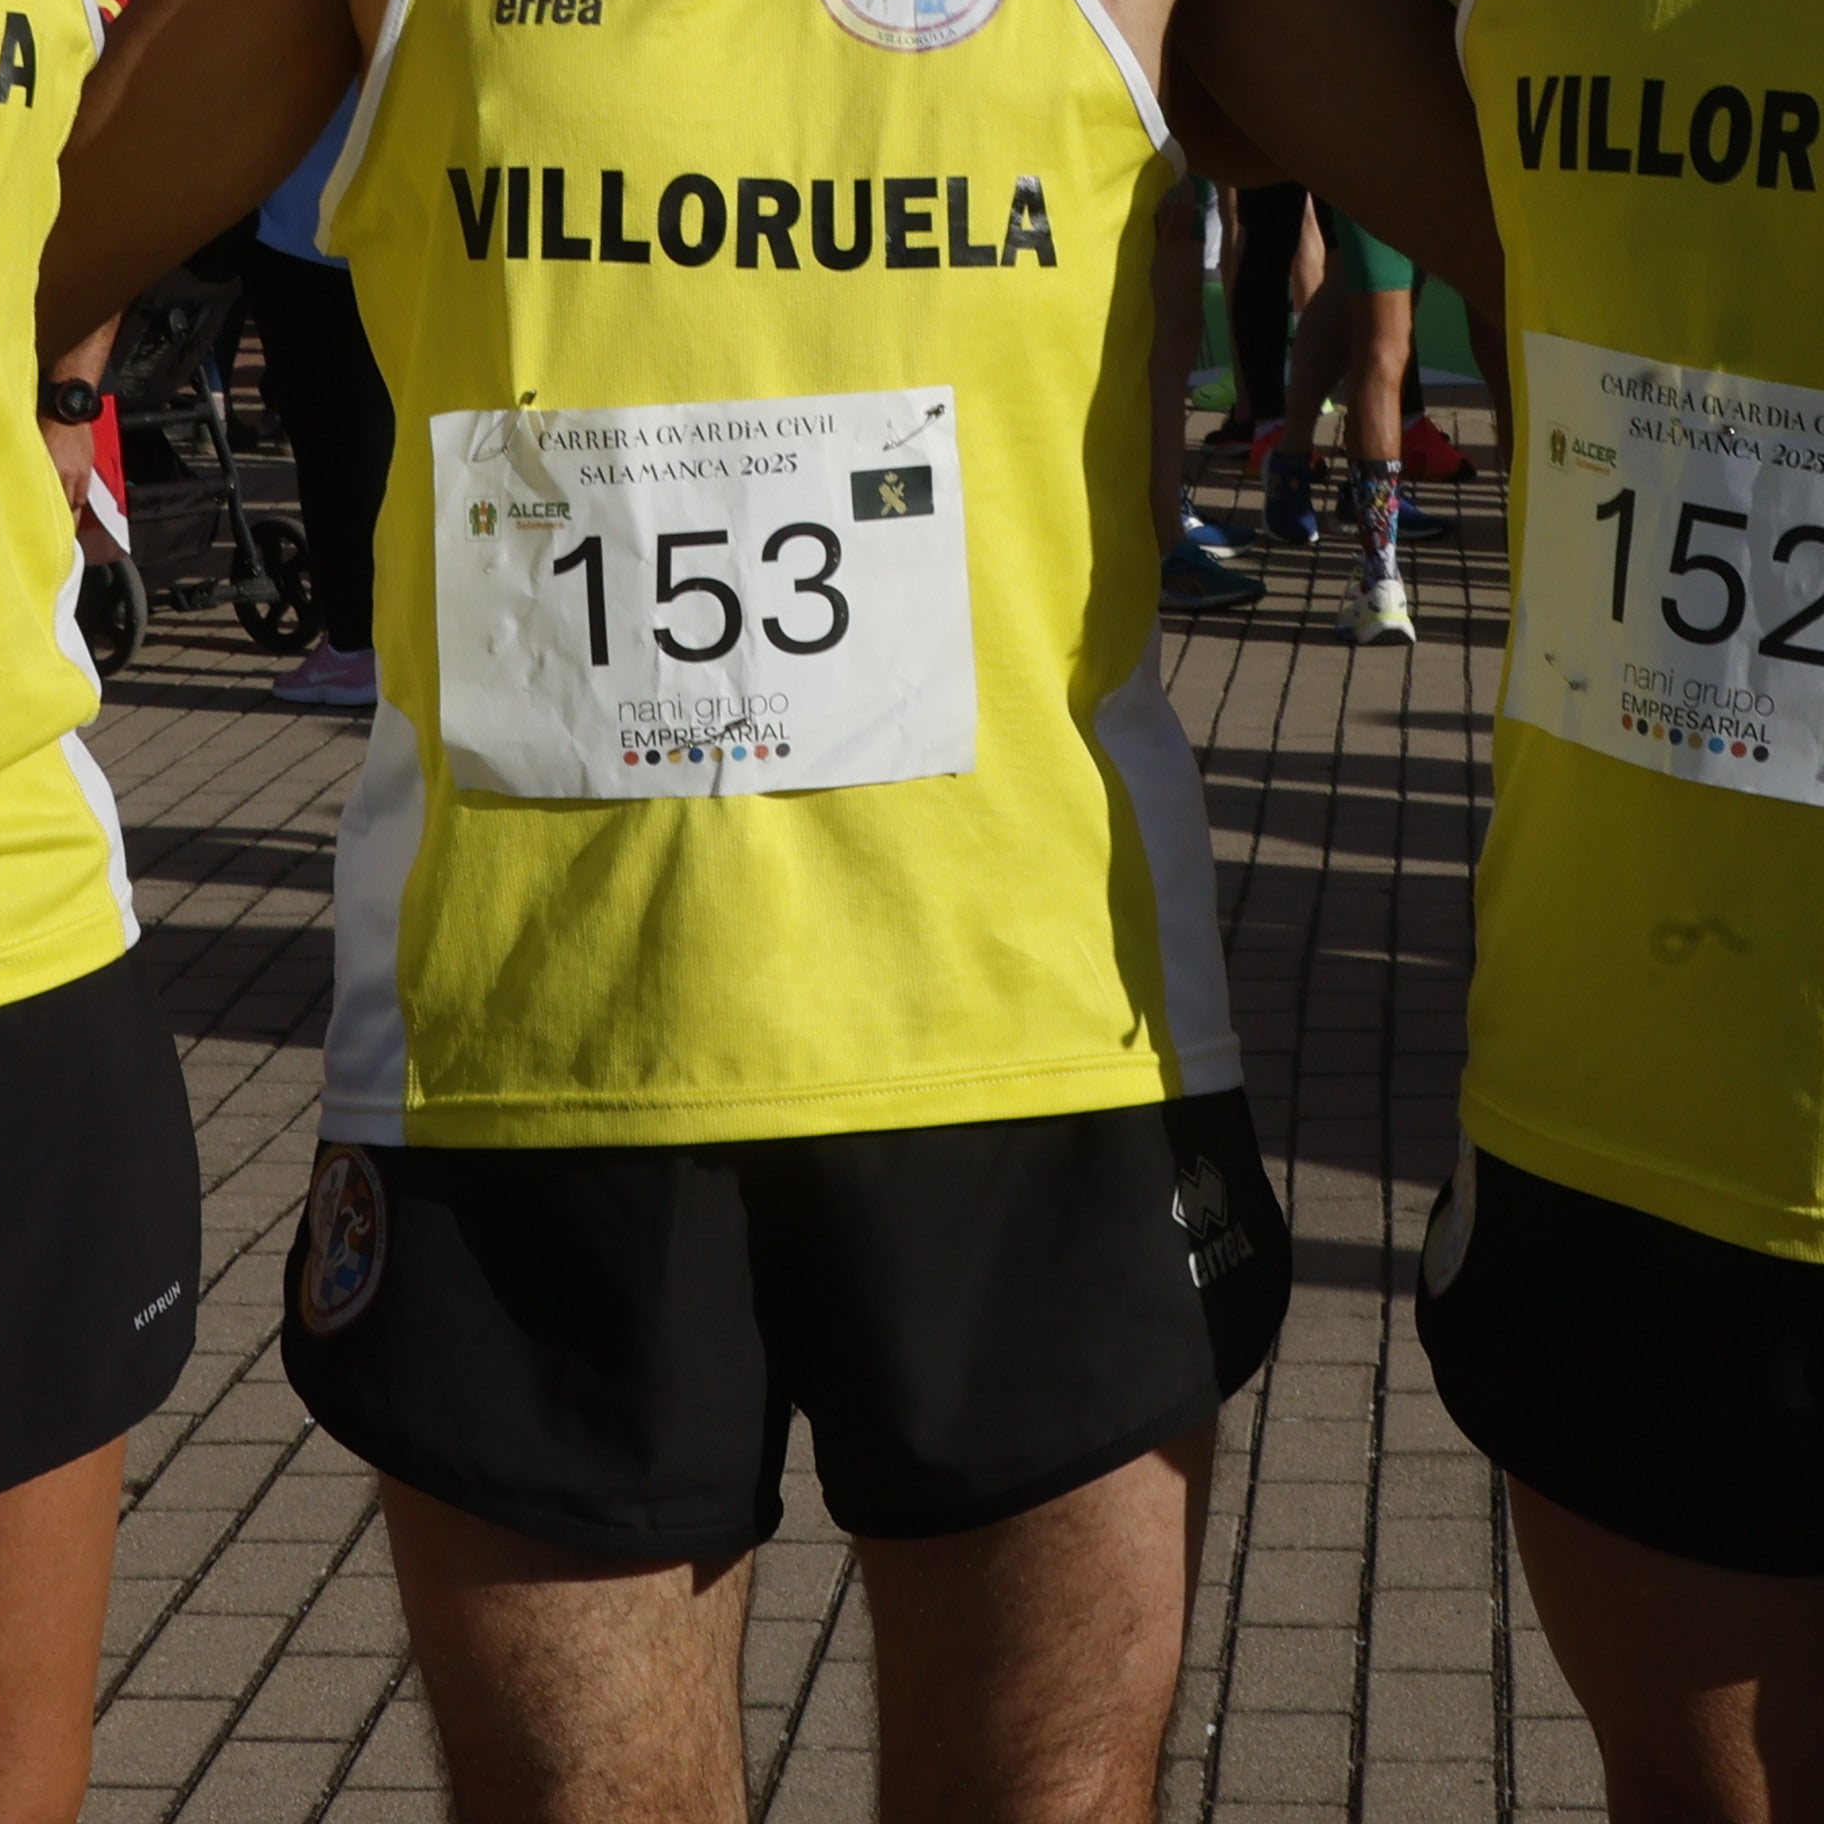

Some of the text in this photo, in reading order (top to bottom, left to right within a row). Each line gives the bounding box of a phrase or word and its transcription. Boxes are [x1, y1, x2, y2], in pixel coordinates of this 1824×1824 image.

[447, 166, 1058, 270] VILLORUELA
[1601, 374, 1696, 412] CARRERA
[538, 427, 648, 453] CARRERA
[1571, 437, 1617, 469] ALCER
[1629, 416, 1763, 463] SALAMANCA
[579, 452, 798, 488] SALAMANCA 2025
[507, 501, 573, 520] ALCER
[553, 522, 850, 666] 153
[618, 691, 790, 725] nani grupo
[1624, 660, 1776, 717] nani grupo
[621, 722, 791, 749] EMPRESARIAL
[1621, 693, 1772, 745] EMPRESARIAL
[1188, 1221, 1255, 1288] errea
[133, 1281, 182, 1331] KIPRUN
